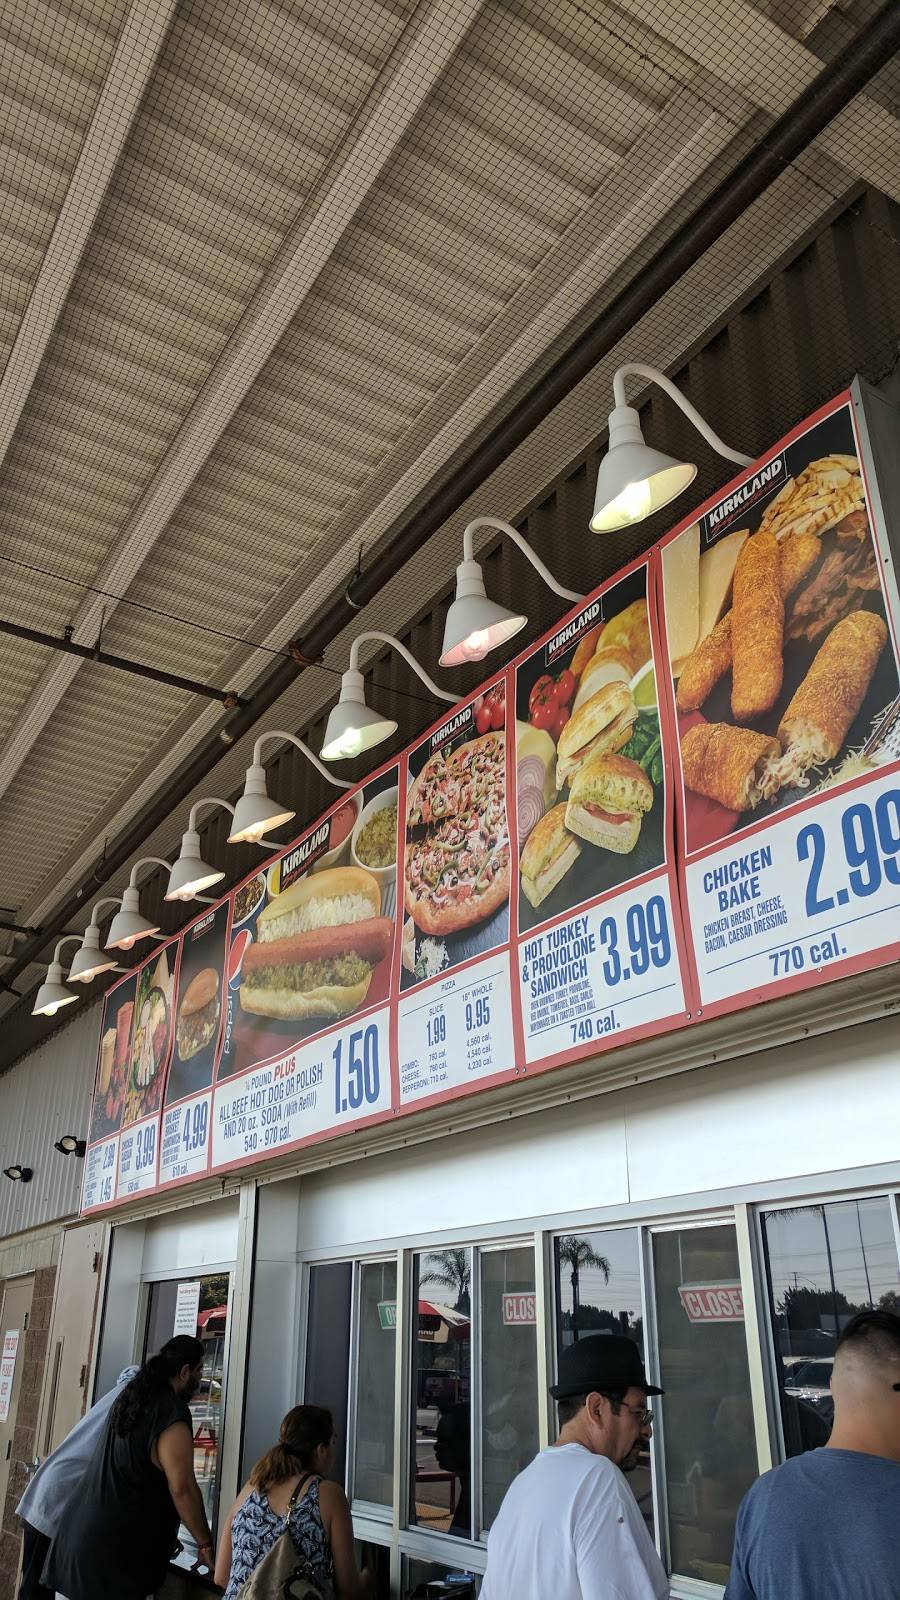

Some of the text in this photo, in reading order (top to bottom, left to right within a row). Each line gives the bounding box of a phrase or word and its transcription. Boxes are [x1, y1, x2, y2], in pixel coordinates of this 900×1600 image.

[709, 459, 782, 527] KIRKLAND
[548, 603, 600, 654] KIRKLAND
[431, 708, 471, 747] KIRKLAND
[283, 823, 330, 877] KIRKLAND
[703, 845, 773, 894] CHICKEN
[796, 788, 900, 918] 2.99
[718, 876, 761, 913] BAKE
[703, 895, 784, 938] CHICKEN BREAST, CHEESE,
[704, 910, 788, 954] BACON, CAESAR DRESSING
[522, 933, 596, 983] & PROVOLONE
[524, 915, 589, 963] HOT TURKEY
[600, 895, 672, 987] 3.99
[768, 932, 847, 977] 770 cal.
[441, 980, 456, 992] PIZZA
[472, 982, 494, 997] WHOLE
[530, 958, 588, 999] SANDWICH
[429, 1003, 444, 1016] SLICE
[465, 996, 490, 1031] 9.95
[570, 1010, 621, 1043] 740 cal.
[426, 1014, 446, 1047] 1.99
[250, 1071, 272, 1089] POUND
[273, 1056, 296, 1081] PLUS
[332, 1023, 380, 1114] 1.50
[401, 1059, 420, 1073] COMBO:
[438, 1048, 447, 1058] cal.
[481, 1032, 492, 1042] cal.
[401, 1069, 422, 1084] CHEESE:
[438, 1060, 448, 1070] cal.
[482, 1043, 492, 1054] cal.
[439, 1071, 449, 1081] cal.
[482, 1056, 494, 1066] cal.
[219, 1062, 323, 1121] ALL BEEF HOT DOG OR POLISH
[183, 1101, 209, 1152] 4.99
[223, 1121, 237, 1140] AND
[237, 1116, 246, 1134] 20
[261, 1103, 282, 1127] SODA
[283, 1100, 298, 1122] (With
[299, 1090, 317, 1110] Refill)
[135, 1124, 156, 1171] 3.99
[244, 1132, 258, 1152] 540
[264, 1125, 278, 1146] 970
[279, 1121, 292, 1141] cal.
[181, 1162, 189, 1175] cal.
[505, 1297, 536, 1320] CLOS
[684, 1290, 744, 1317] CLOSE
